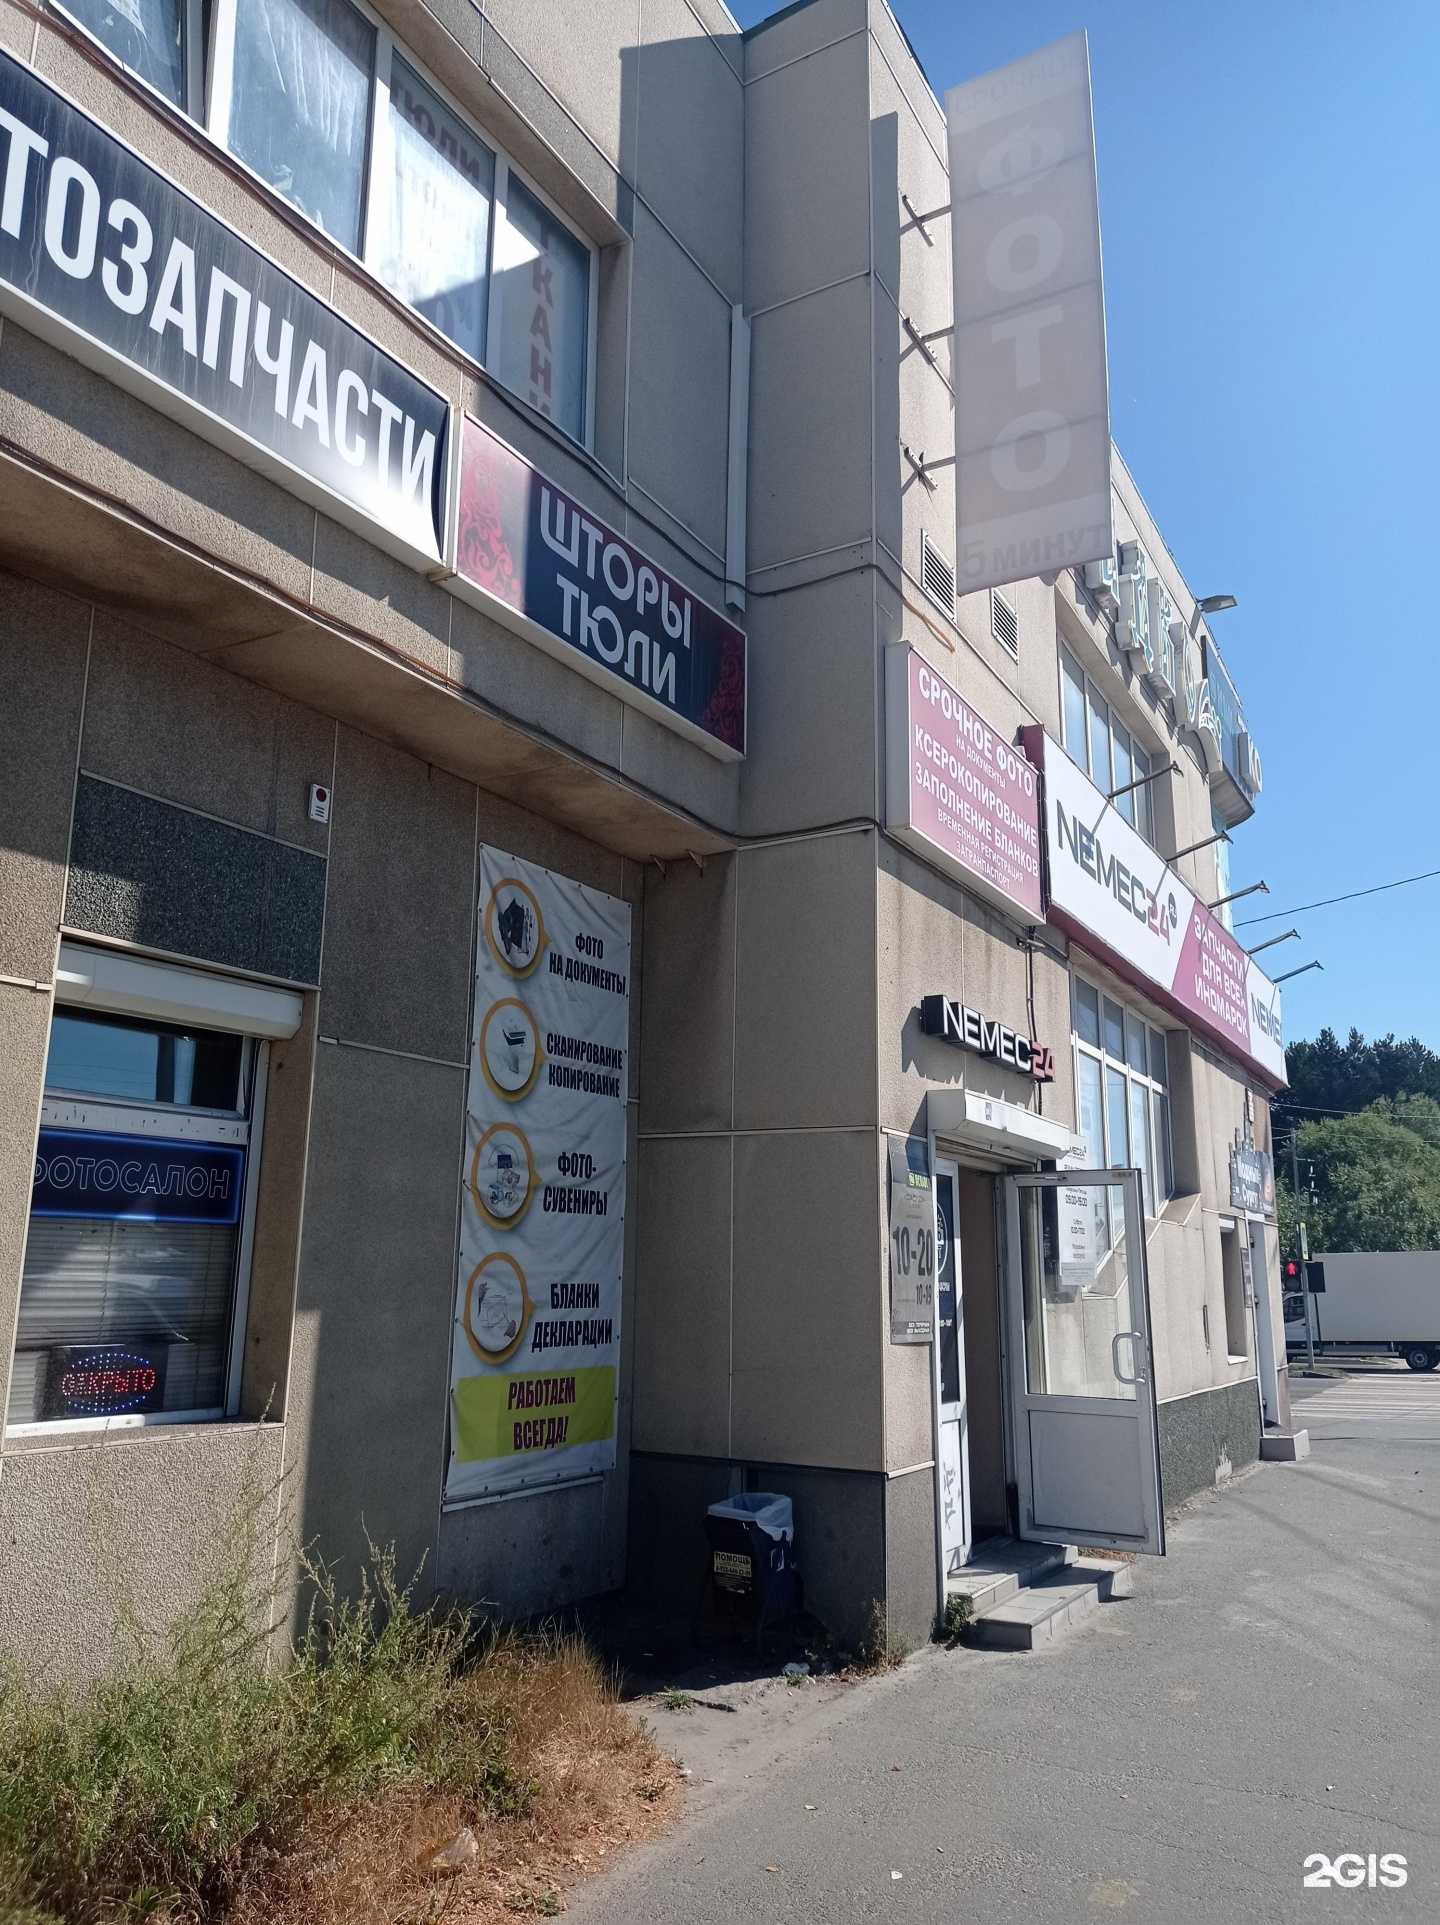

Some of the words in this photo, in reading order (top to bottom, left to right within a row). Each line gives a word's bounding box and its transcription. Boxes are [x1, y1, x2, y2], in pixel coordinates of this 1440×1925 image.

[0, 110, 436, 494] ТОЗАПЧАСТИ
[541, 487, 691, 648] ШТОРЫ
[557, 573, 676, 704] ТЮЛИ
[918, 667, 993, 760] СРОЧНОЕ
[997, 745, 1033, 797] ФОТО
[915, 725, 1037, 848] КСЕРОКОПИРОВАНИЕ
[956, 735, 965, 753] НА
[966, 744, 1006, 788] ДОКУМЕНТЫ
[915, 762, 992, 842] ЗАПОЛНЕНИЕ
[995, 828, 1039, 877] БЛАНКОВ
[937, 808, 979, 849] ВРЕМЕННАЯ
[980, 842, 1024, 882] РЕГИСТРАЦИЯ
[956, 840, 1010, 889] ЗАГРАНПАСПОРТ
[575, 932, 604, 960] ФОТО
[1194, 914, 1245, 983] ЗАПЧАСТИ
[549, 951, 563, 975] НА
[564, 960, 626, 996] ДОКУМЕНТЫ
[1202, 952, 1222, 989] ДЛЯ
[1224, 972, 1247, 1012] ВСЕХ
[1195, 973, 1248, 1038] ИНОМАРОК
[546, 1032, 623, 1070] СКАНИРОВАНИЕ
[942, 995, 1056, 1079] NEMEC24
[549, 1063, 620, 1098] КОПИРОВАНИЕ
[557, 1152, 597, 1179] ФОТО-
[543, 1185, 607, 1216] СУВЕНИРЫ
[893, 1225, 932, 1277] 10-20
[550, 1283, 600, 1309] БЛАНКИ
[531, 1319, 612, 1352] ДЕКЛАРАЦИИ
[507, 1377, 576, 1410] РАБОТАЕМ
[513, 1415, 569, 1450] ВСЕГДА!
